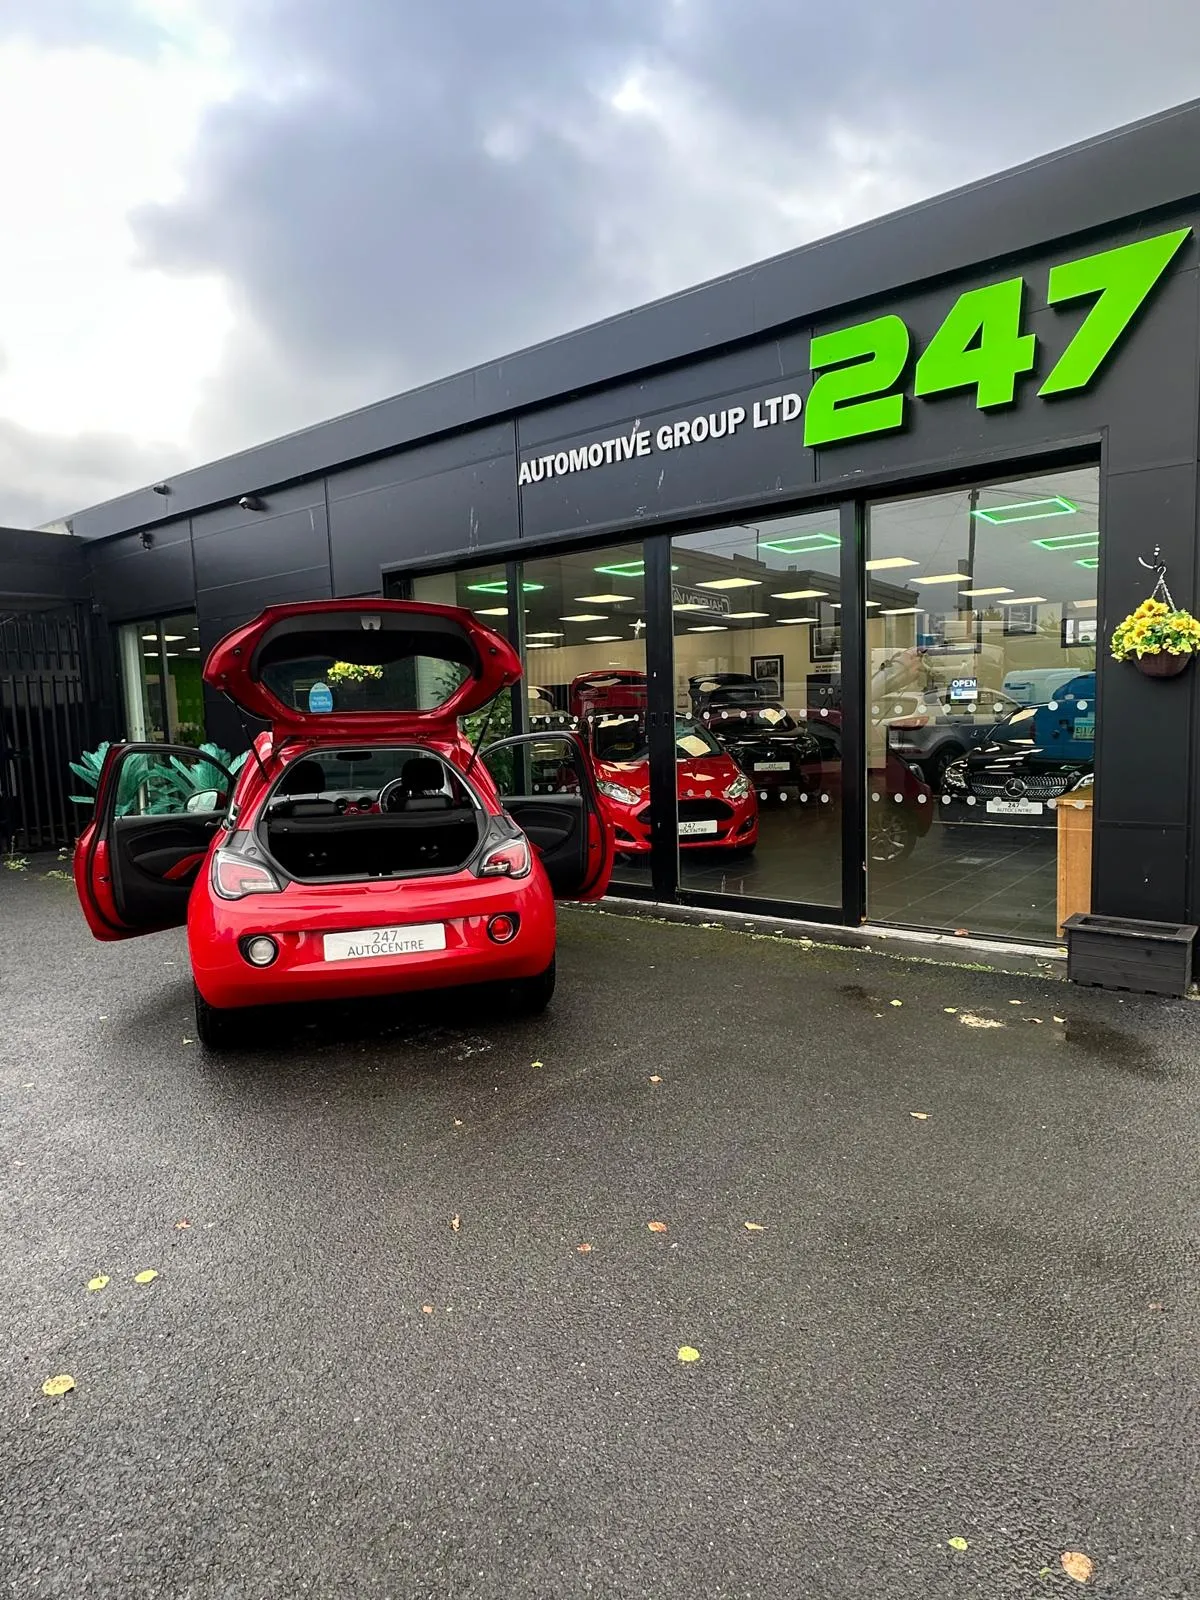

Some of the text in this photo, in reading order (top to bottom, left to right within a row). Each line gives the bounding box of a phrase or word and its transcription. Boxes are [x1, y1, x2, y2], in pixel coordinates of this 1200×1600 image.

[803, 226, 1193, 448] 247
[518, 393, 803, 486] AUTOMOTIVE GROUP LTD
[952, 679, 977, 688] OPEN
[683, 822, 696, 830] 247
[372, 930, 399, 944] 247
[347, 939, 424, 957] AUTOCENTRE
